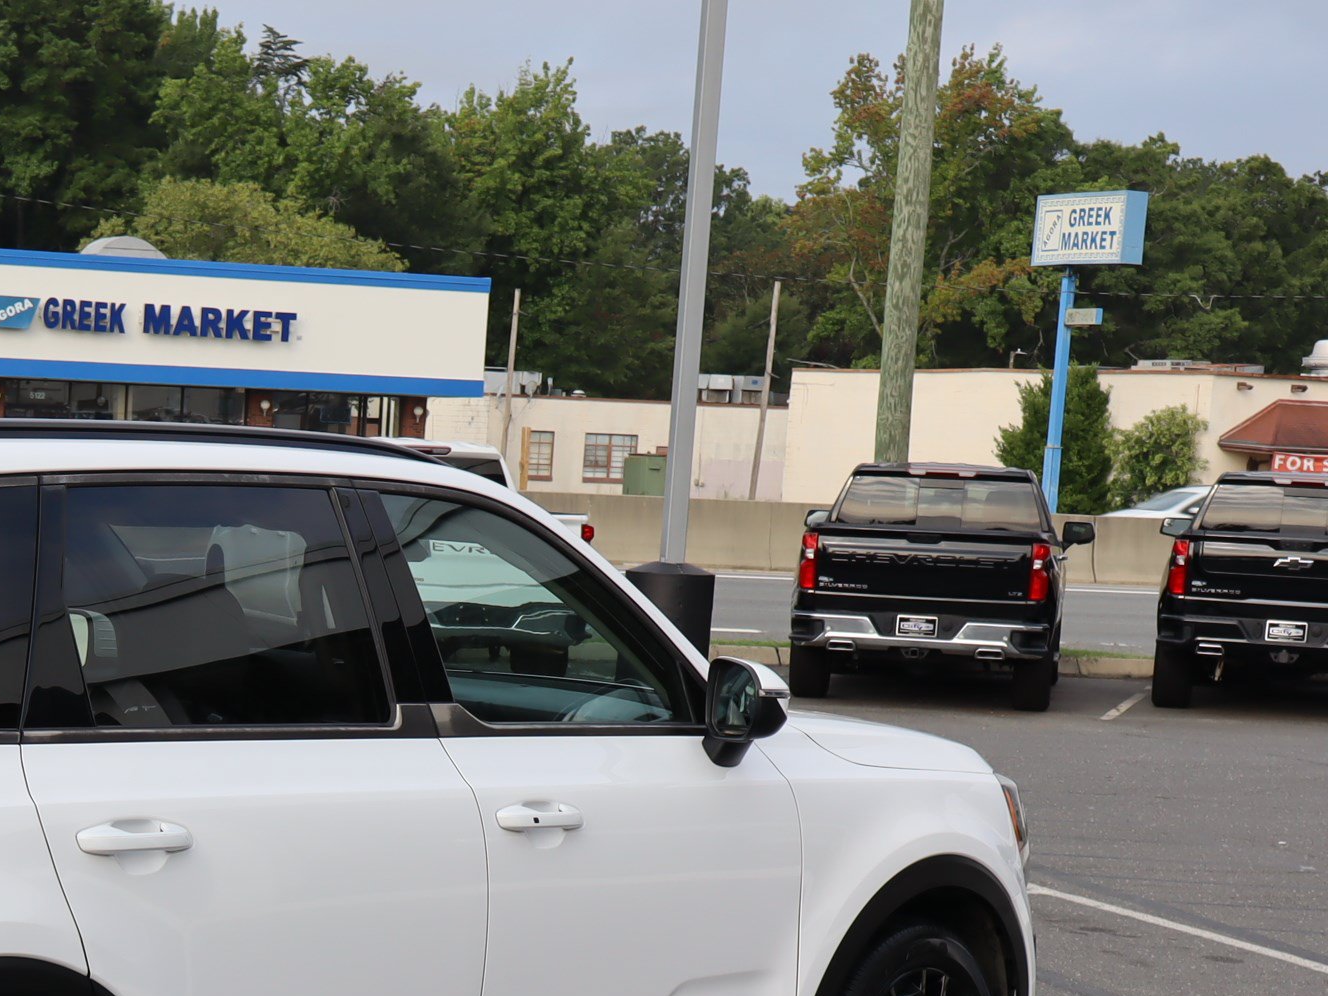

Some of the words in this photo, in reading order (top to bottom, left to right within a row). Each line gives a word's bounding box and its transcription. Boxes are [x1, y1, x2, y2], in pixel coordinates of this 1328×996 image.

[1069, 207, 1112, 228] GREEK
[1043, 214, 1062, 248] AGORA
[1061, 231, 1116, 250] MARKET
[43, 297, 126, 333] GREEK
[143, 303, 297, 342] MARKET
[1274, 454, 1314, 471] FOR
